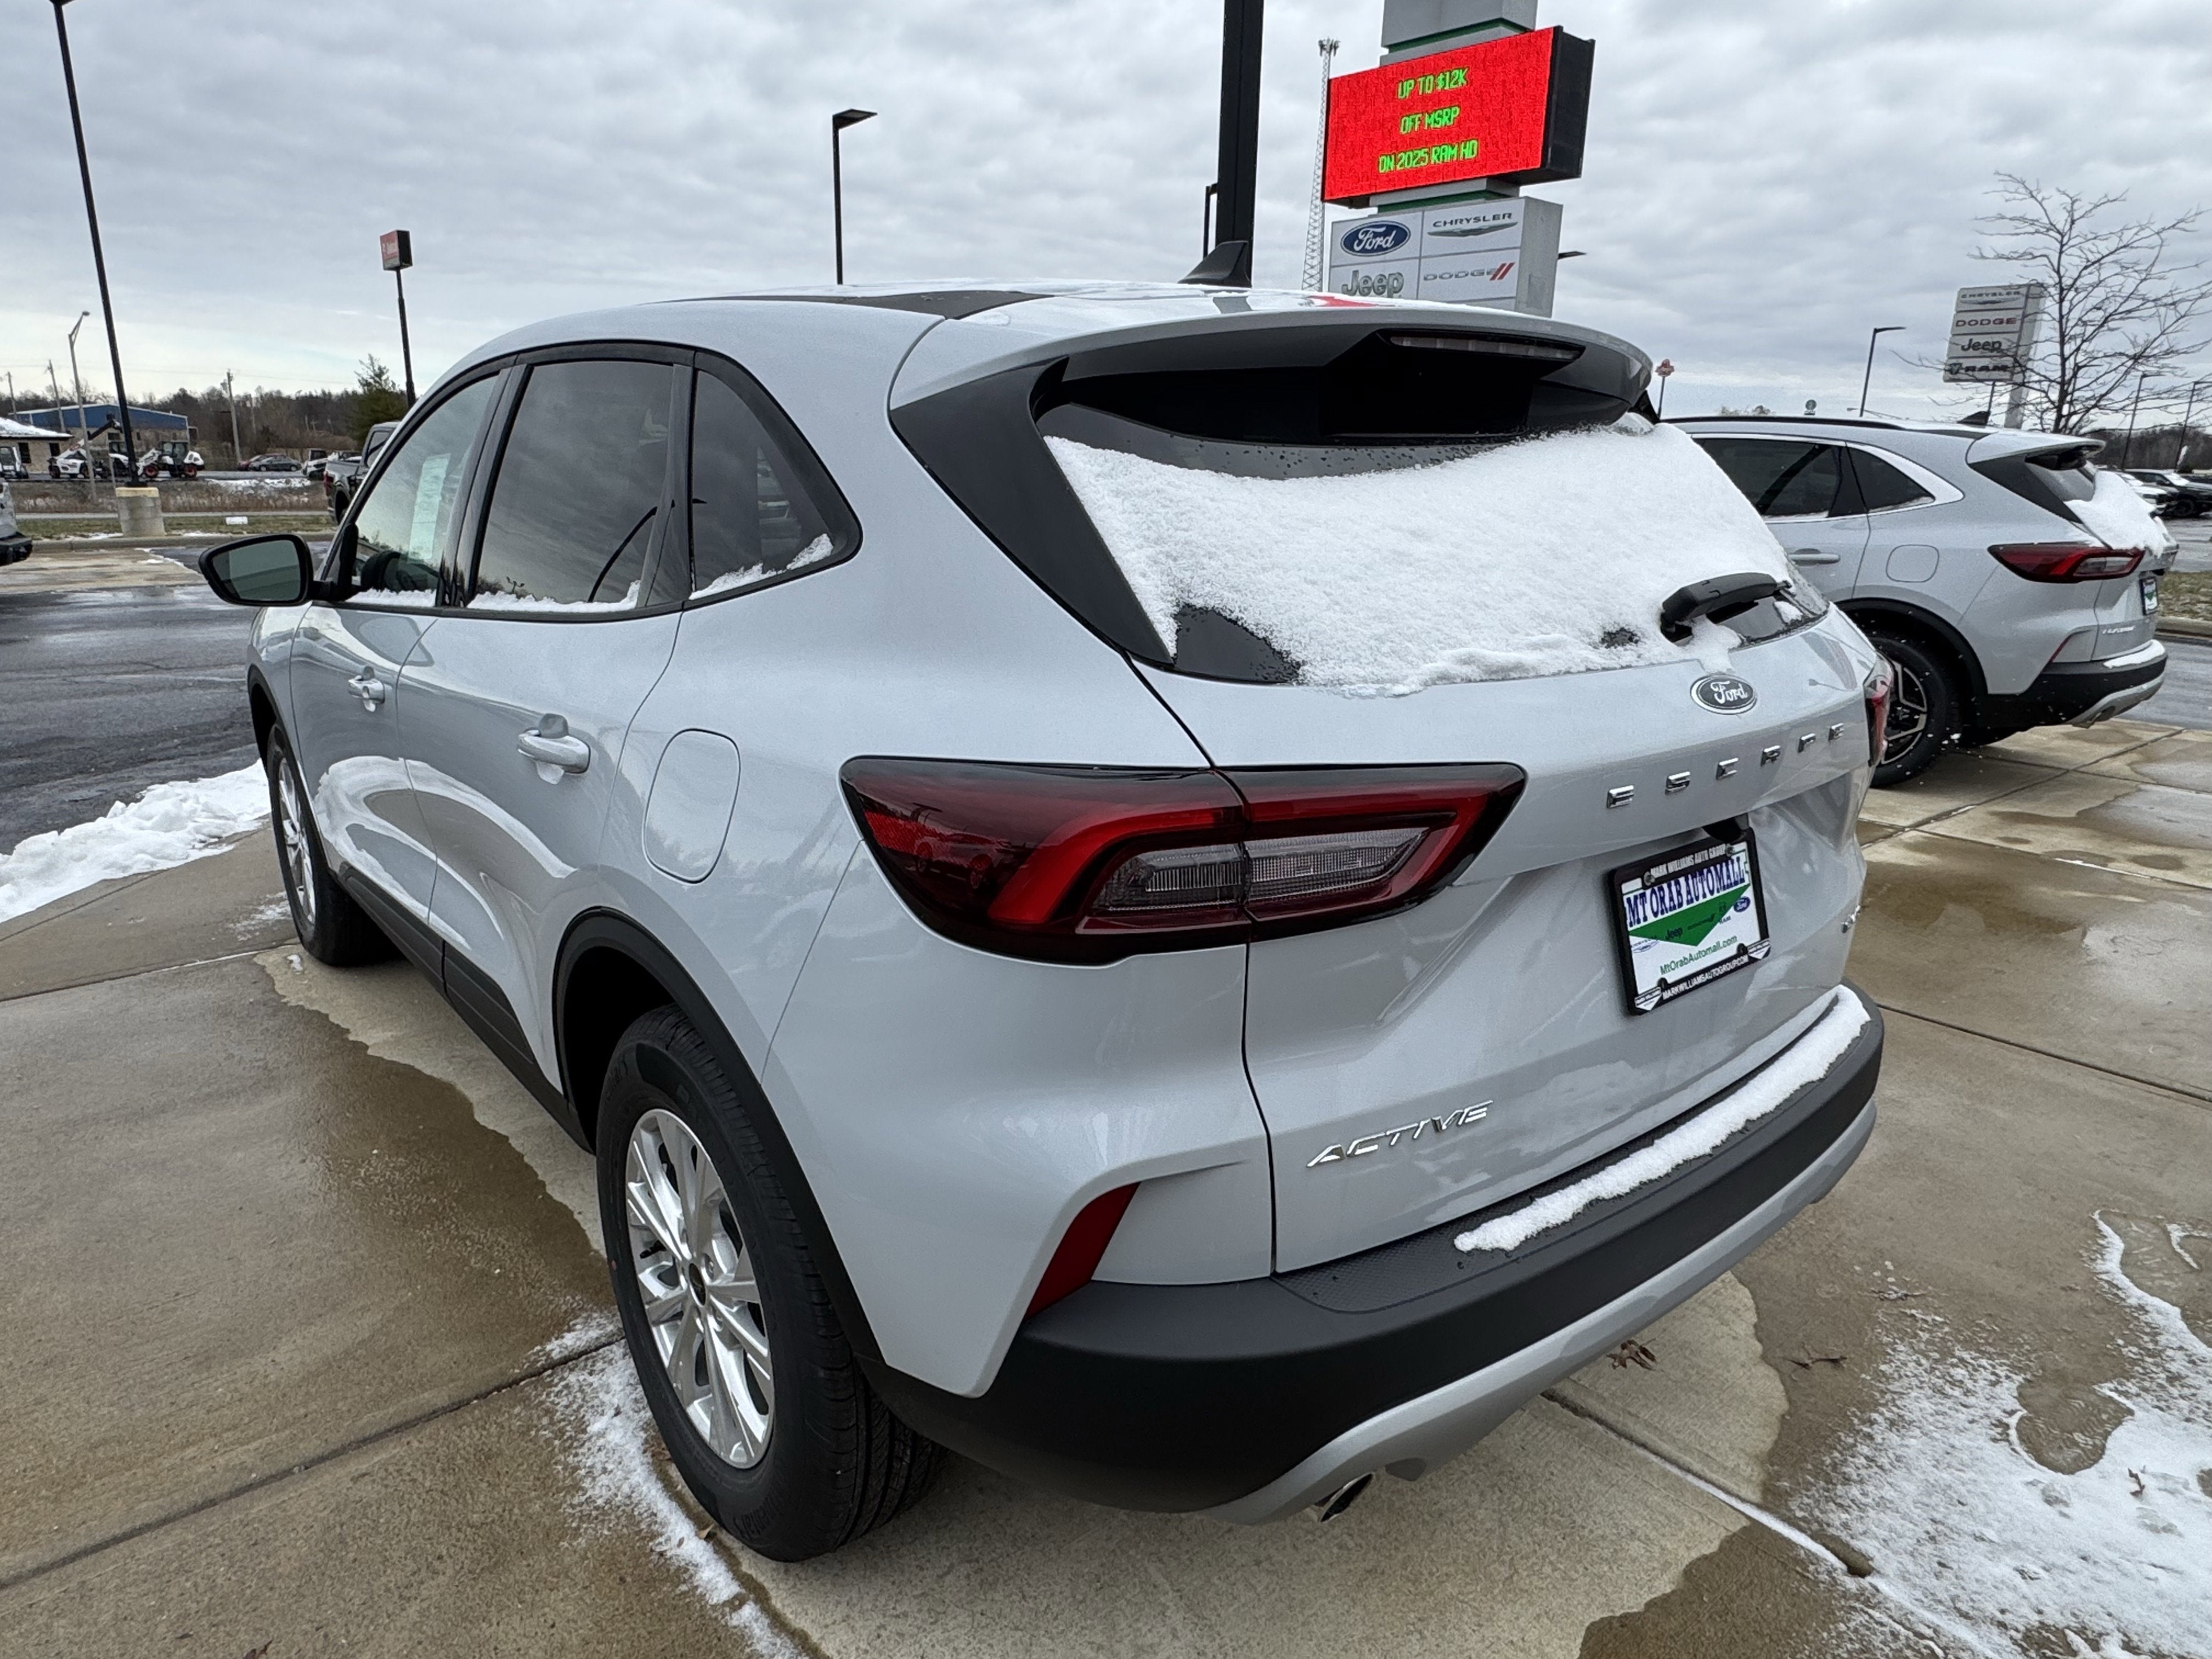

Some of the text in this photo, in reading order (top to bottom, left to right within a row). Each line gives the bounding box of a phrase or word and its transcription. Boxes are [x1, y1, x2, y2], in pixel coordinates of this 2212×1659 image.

[1398, 67, 1469, 99] UP TO $12K
[1401, 105, 1460, 134] OFF MSRP
[1379, 139, 1479, 173] ON 2025 RAM HD
[1432, 212, 1513, 228] CHRYSLER
[1353, 227, 1395, 252] Ford
[1341, 269, 1404, 298] Jeep
[1423, 267, 1498, 281] DODGE
[1955, 317, 2017, 328] DODGE
[1961, 338, 2002, 353] Jeep
[1710, 680, 1748, 704] Ford
[1606, 723, 1845, 809] ESCAPE
[1626, 891, 1648, 927] MT
[1650, 878, 1683, 918] ORAB
[1684, 856, 1746, 906] AUTOMALL
[1660, 935, 1738, 975] MtOrabAutomall.com
[1306, 1099, 1493, 1168] ACTIVE
